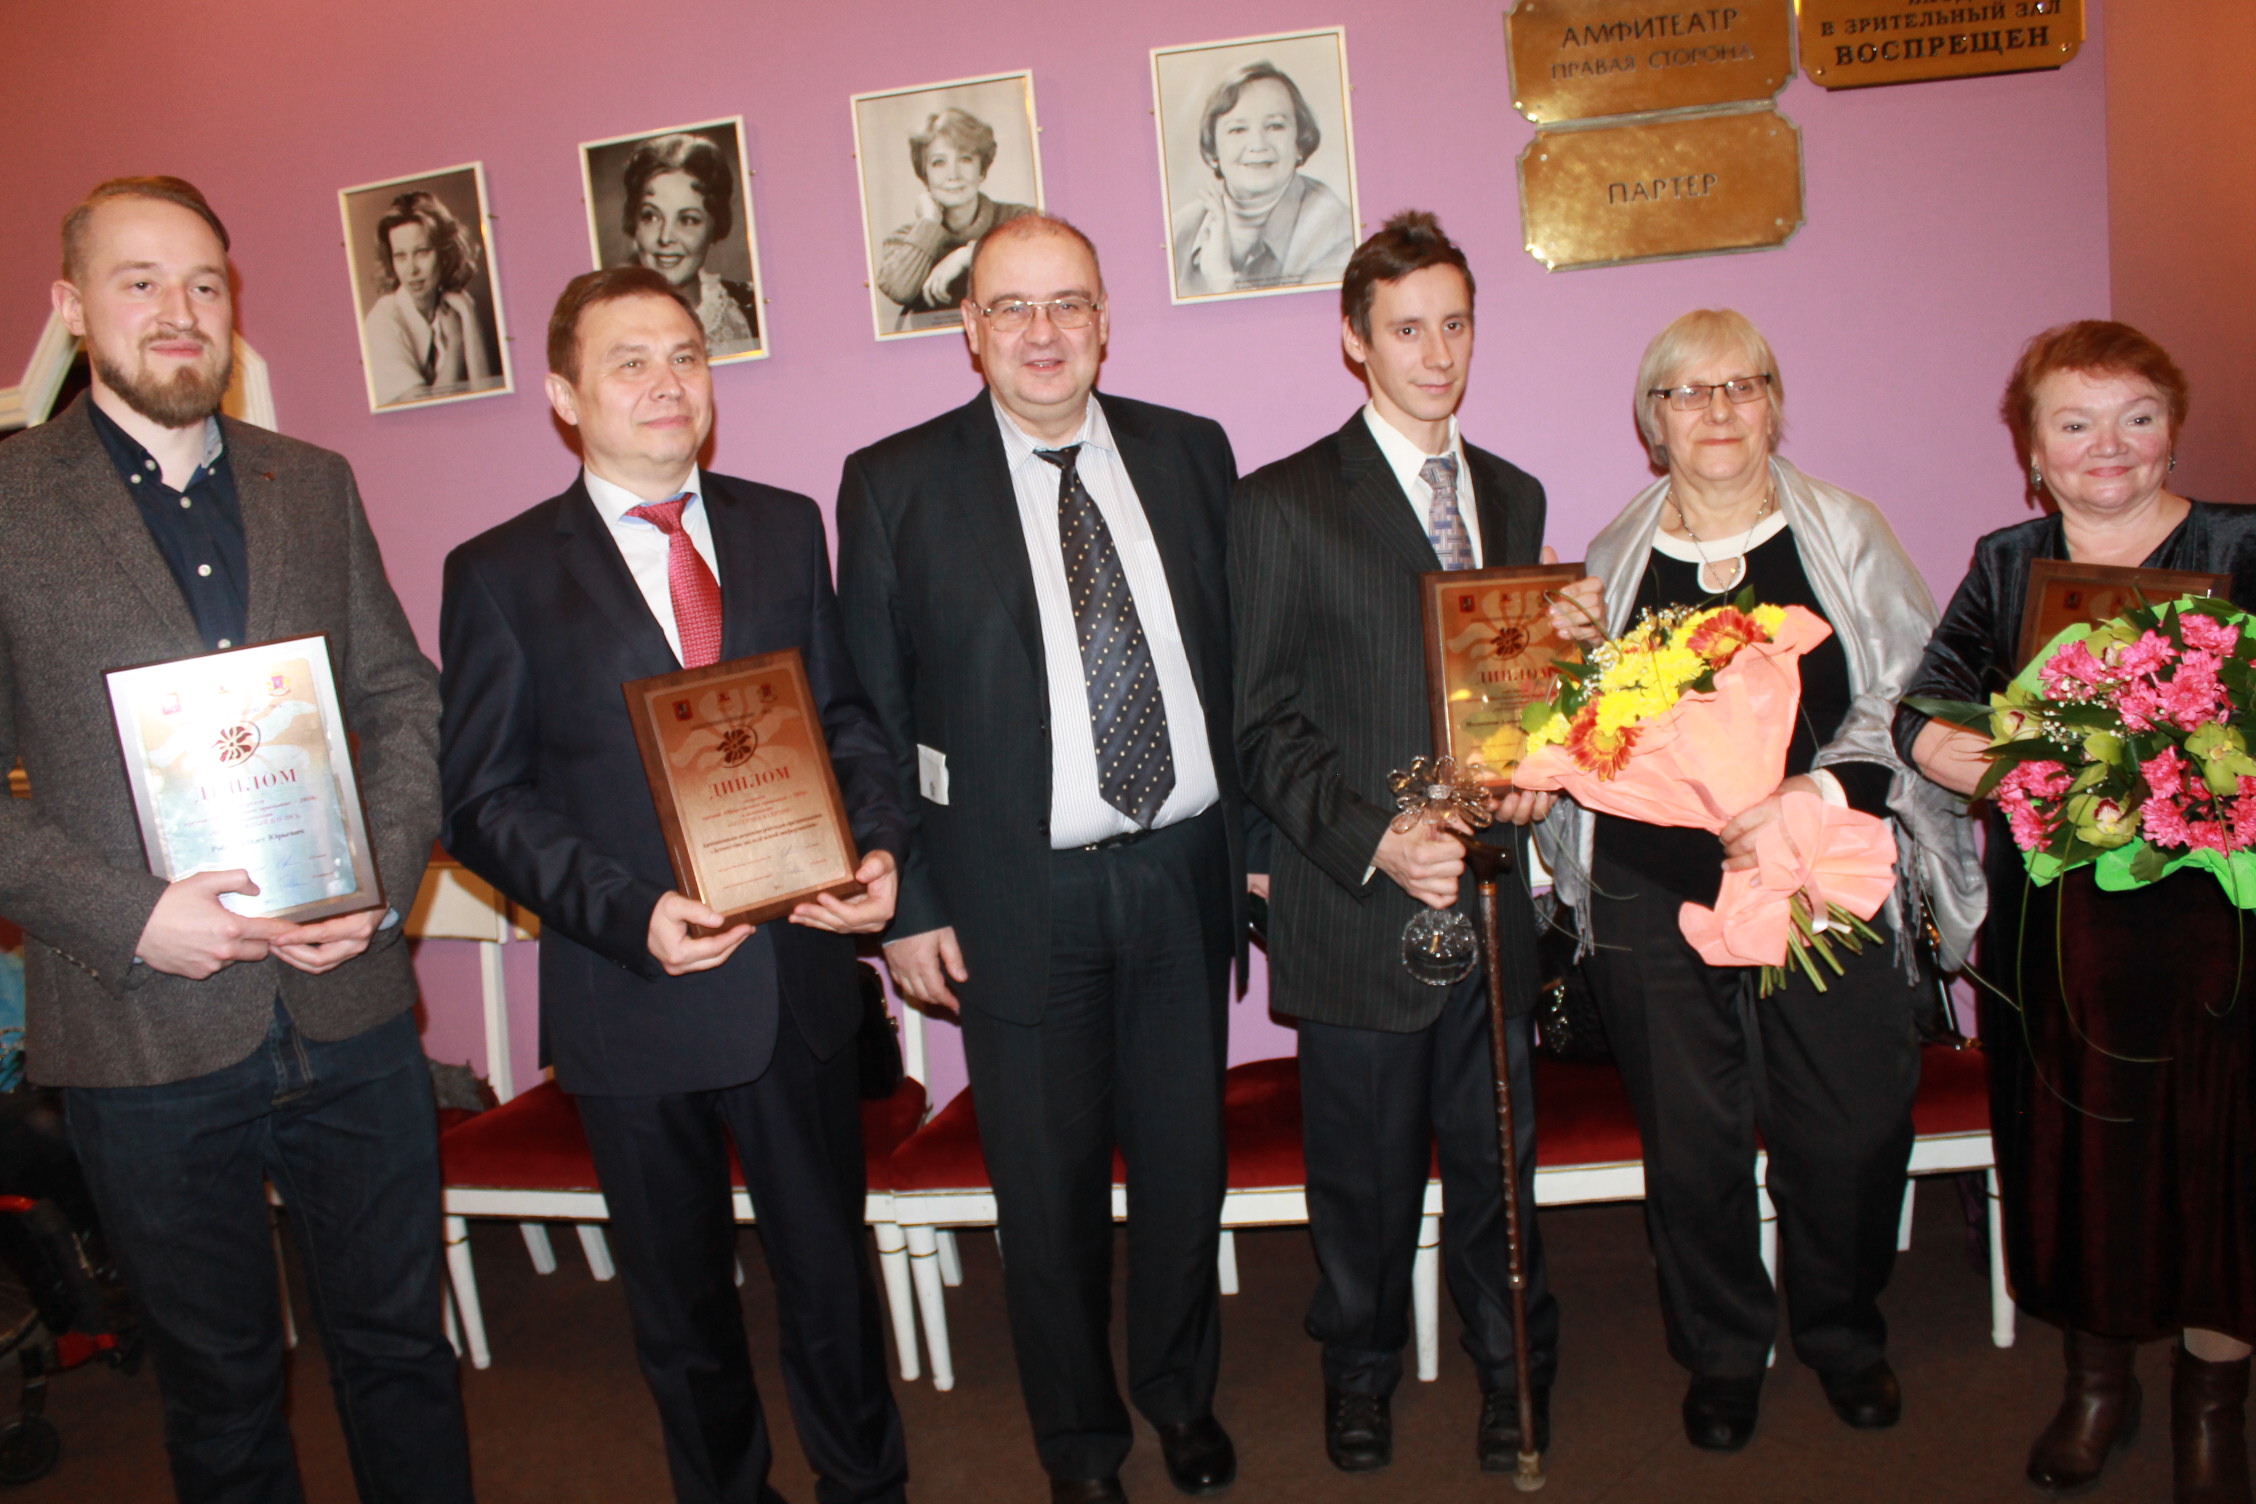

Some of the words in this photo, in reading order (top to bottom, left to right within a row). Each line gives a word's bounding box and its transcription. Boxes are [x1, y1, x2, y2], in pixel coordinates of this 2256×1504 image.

[1561, 7, 1738, 50] АМФИТЕАТР
[1820, 21, 1835, 37] В
[1844, 3, 2007, 35] ЗРИТЕЛЬНЫЙ
[2015, 1, 2062, 19] ЗАЛ
[1550, 55, 1636, 81] ПРАВАЯ
[1648, 42, 1755, 70] СТОРОНА
[1835, 25, 2051, 67] ВОСПРЕЩЕН
[1607, 173, 1718, 205] ПАРТЕР
[194, 768, 298, 804] ДПЛОМ
[709, 766, 791, 800] ДИПЛОМ
